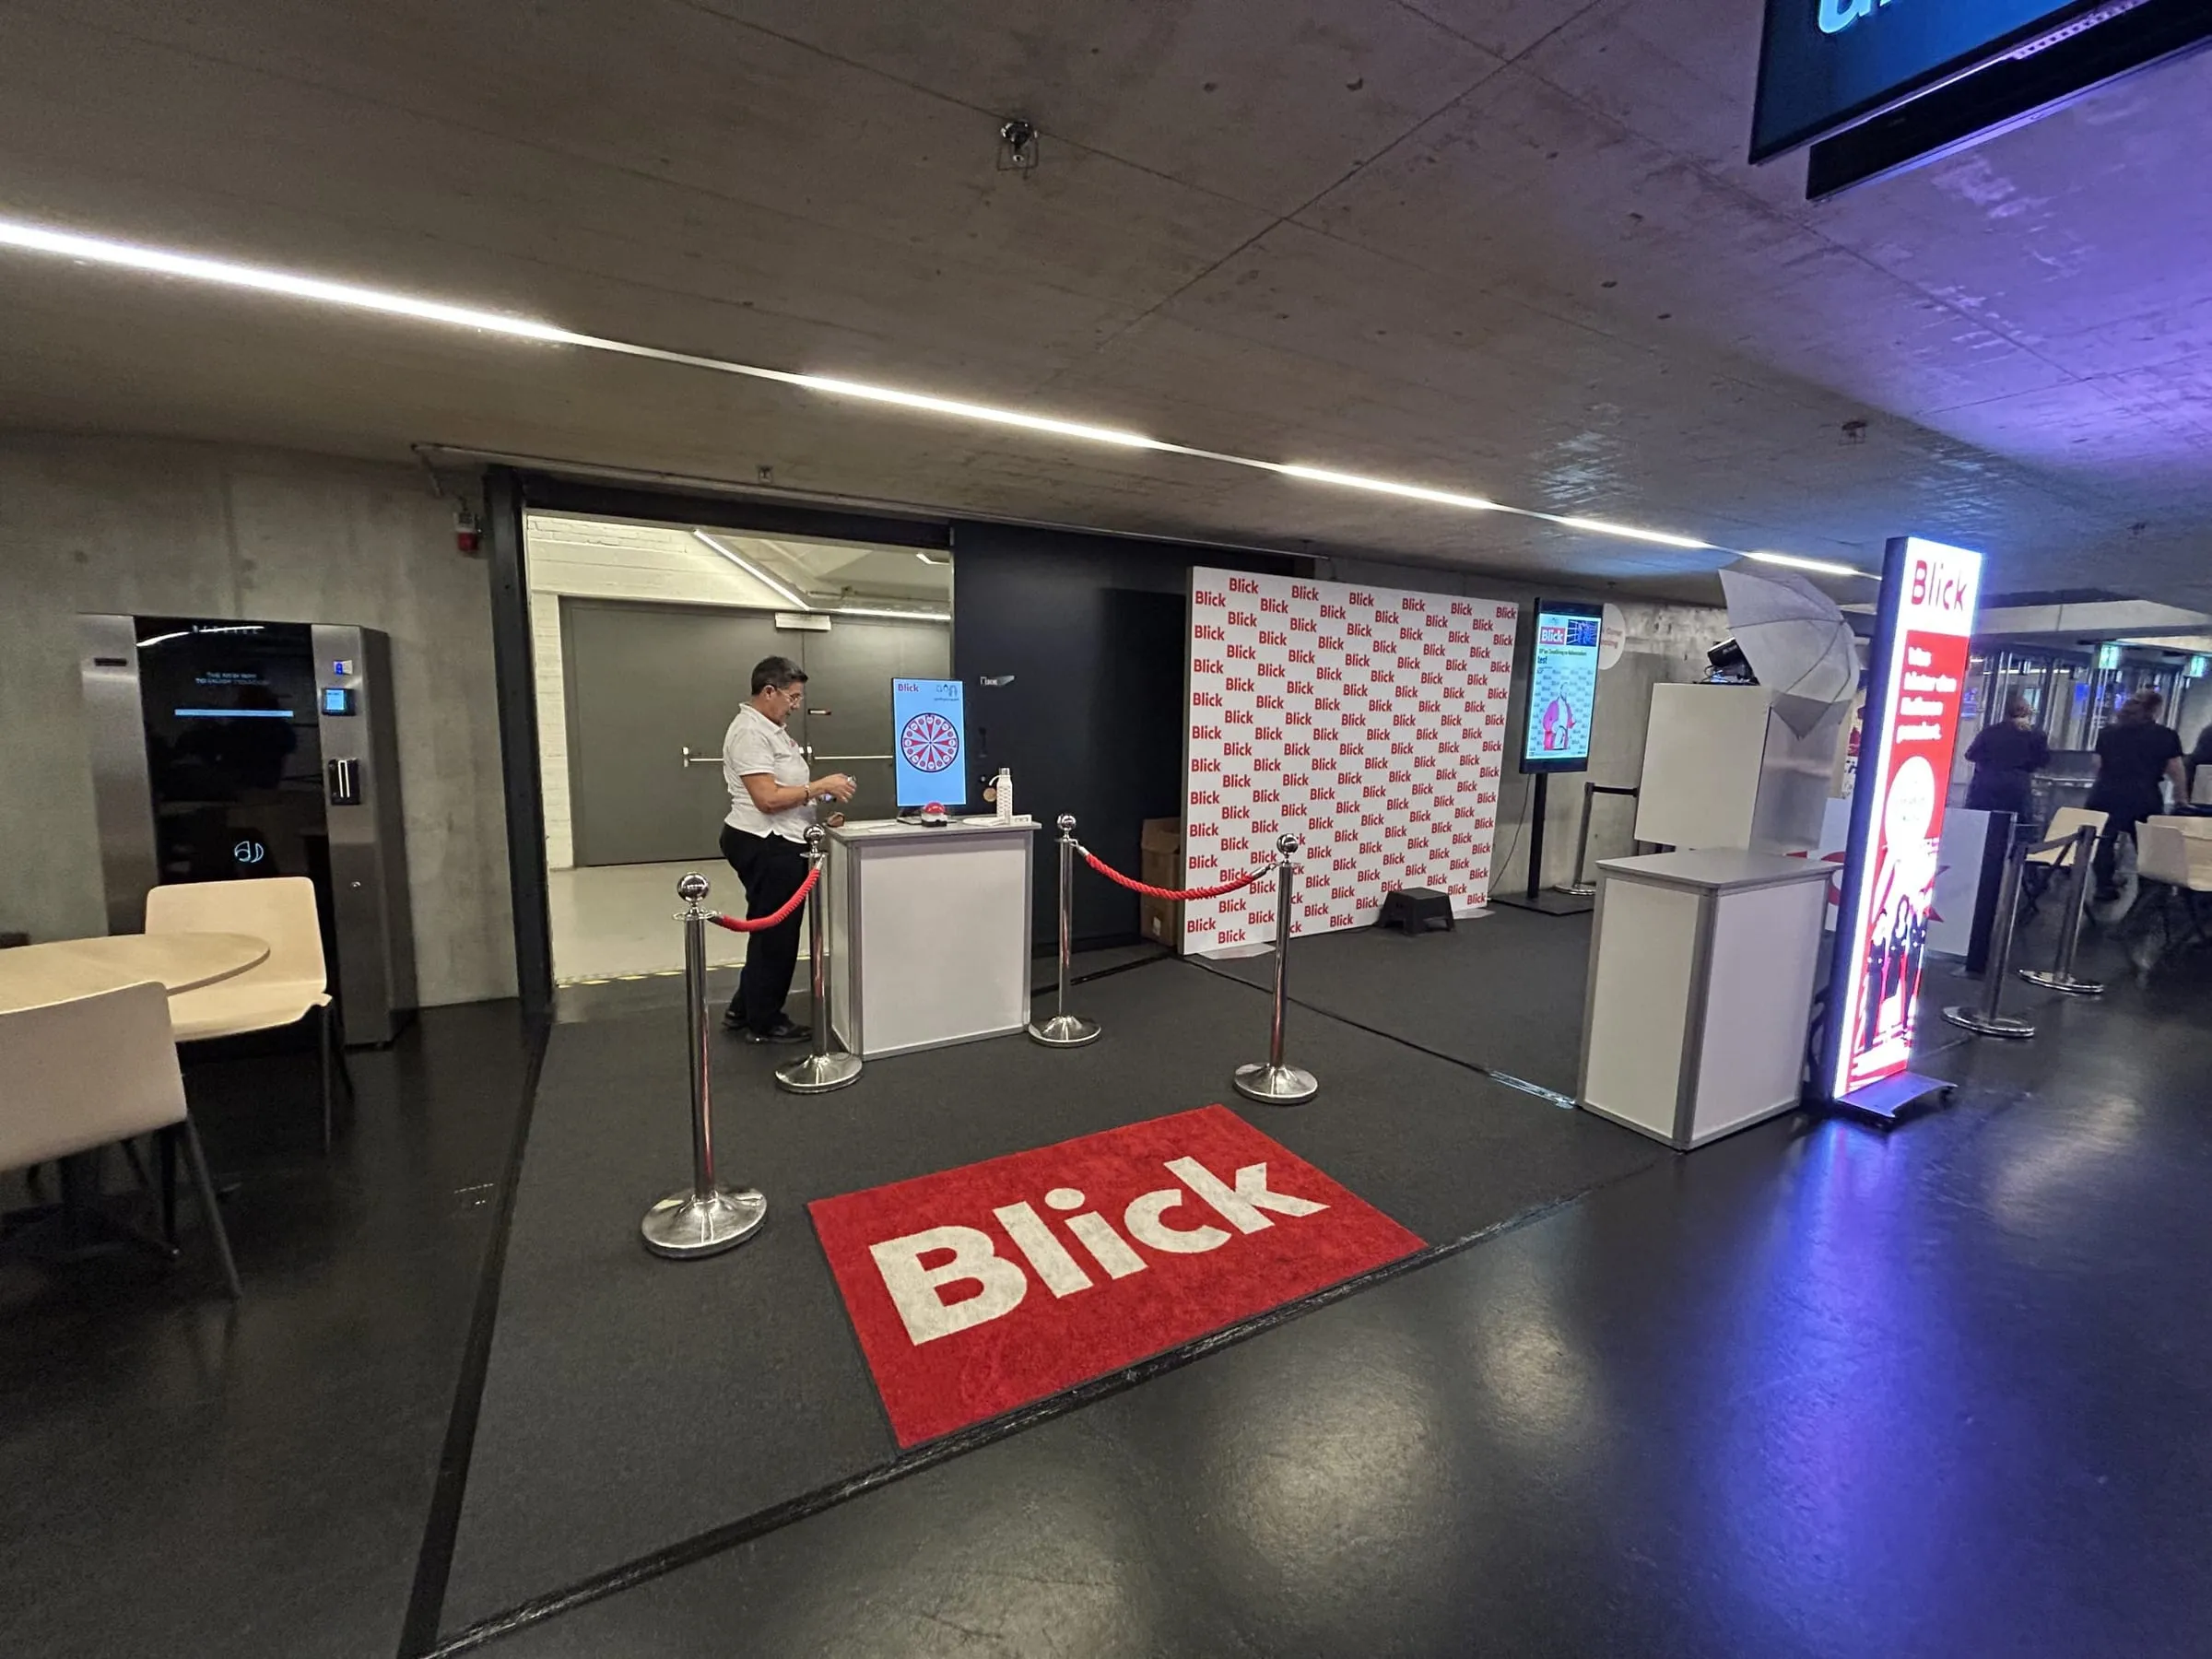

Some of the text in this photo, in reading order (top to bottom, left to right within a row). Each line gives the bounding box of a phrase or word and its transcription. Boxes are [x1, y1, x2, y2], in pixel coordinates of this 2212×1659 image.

[1230, 577, 1259, 594] Blick
[1911, 559, 1967, 612] Blick
[1195, 591, 1226, 607] Blick
[1292, 585, 1319, 601] Blick
[1349, 592, 1374, 606] Blick
[1261, 597, 1288, 614] Blick
[1402, 597, 1426, 612] Blick
[1451, 603, 1473, 616] Blick
[1320, 605, 1346, 619] Blick
[1375, 610, 1399, 625] Blick
[1496, 606, 1516, 618] Blick
[1228, 611, 1257, 627] Blick
[1290, 618, 1317, 632] Blick
[1426, 615, 1448, 628] Blick
[1473, 618, 1493, 631] Blick
[1194, 625, 1224, 641] Blick
[1347, 623, 1371, 637] Blick
[1400, 627, 1423, 641] Blick
[1448, 630, 1470, 643] Blick
[1542, 629, 1564, 642] Blick
[1259, 630, 1287, 646] Blick
[1318, 636, 1344, 650] Blick
[1493, 634, 1512, 646] Blick
[1227, 644, 1256, 660] Blick
[1373, 640, 1397, 653] Blick
[1423, 643, 1445, 656] Blick
[1469, 646, 1490, 658] Blick
[1288, 649, 1315, 664] Blick
[1346, 653, 1370, 667] Blick
[1397, 656, 1420, 669] Blick
[1194, 658, 1224, 674] Blick
[1257, 664, 1285, 677] Blick
[1445, 658, 1467, 671] Blick
[1490, 661, 1511, 674] Blick
[1316, 667, 1342, 680] Blick
[1371, 670, 1394, 683] Blick
[1420, 672, 1442, 685] Blick
[1467, 674, 1488, 686] Blick
[898, 683, 919, 692] Blick
[1226, 677, 1254, 692] Blick
[1287, 680, 1314, 695] Blick
[1343, 684, 1368, 697] Blick
[1395, 686, 1418, 698] Blick
[1443, 687, 1465, 699] Blick
[1488, 688, 1508, 700] Blick
[1194, 692, 1222, 707] Blick
[1256, 695, 1284, 709] Blick
[1314, 697, 1340, 711] Blick
[1369, 699, 1392, 712] Blick
[1418, 700, 1441, 712] Blick
[1465, 700, 1486, 712] Blick
[1225, 710, 1253, 724] Blick
[1285, 712, 1312, 725] Blick
[1342, 713, 1366, 726] Blick
[1394, 714, 1416, 726] Blick
[1441, 714, 1462, 726] Blick
[1485, 714, 1504, 725] Blick
[1193, 724, 1222, 739] Blick
[1255, 726, 1283, 740] Blick
[1313, 727, 1338, 741] Blick
[1367, 728, 1390, 741] Blick
[1416, 728, 1438, 740] Blick
[1462, 728, 1482, 739] Blick
[1224, 742, 1252, 756] Blick
[1284, 743, 1311, 756] Blick
[1339, 743, 1364, 756] Blick
[1391, 742, 1414, 755] Blick
[1438, 741, 1460, 754] Blick
[1482, 740, 1501, 752] Blick
[1192, 758, 1220, 772] Blick
[1253, 758, 1281, 771] Blick
[1312, 758, 1336, 771] Blick
[1365, 758, 1388, 769] Blick
[1414, 756, 1436, 768] Blick
[1460, 754, 1480, 766] Blick
[1338, 772, 1362, 784] Blick
[1389, 771, 1411, 782] Blick
[1436, 769, 1457, 781] Blick
[1479, 767, 1499, 778] Blick
[1223, 774, 1251, 788] Blick
[1283, 773, 1309, 786] Blick
[1310, 787, 1335, 800] Blick
[1362, 785, 1386, 798] Blick
[1412, 783, 1433, 795] Blick
[1457, 781, 1477, 793] Blick
[1191, 791, 1220, 805] Blick
[1253, 789, 1279, 803] Blick
[1434, 795, 1454, 807] Blick
[1477, 792, 1496, 804] Blick
[1281, 804, 1307, 817] Blick
[1336, 801, 1360, 814] Blick
[1387, 798, 1409, 811] Blick
[1222, 806, 1250, 819] Blick
[1409, 810, 1430, 822] Blick
[1454, 806, 1475, 818] Blick
[1252, 819, 1278, 833] Blick
[1309, 817, 1334, 830] Blick
[1360, 813, 1384, 826] Blick
[1475, 818, 1493, 830] Blick
[1190, 822, 1218, 837] Blick
[1384, 826, 1407, 839] Blick
[1431, 821, 1453, 833] Blick
[1335, 830, 1359, 842] Blick
[1453, 832, 1472, 844] Blick
[1220, 837, 1249, 851] Blick
[1359, 841, 1382, 854] Blick
[1407, 837, 1429, 850] Blick
[1472, 842, 1490, 855] Blick
[1250, 850, 1277, 865] Blick
[1307, 846, 1332, 859] Blick
[1382, 853, 1405, 865] Blick
[1429, 848, 1450, 860] Blick
[1189, 854, 1218, 869] Blick
[1333, 858, 1357, 871] Blick
[1450, 857, 1469, 870] Blick
[1358, 869, 1381, 882] Blick
[1406, 865, 1427, 877] Blick
[1469, 868, 1488, 880] Blick
[1306, 874, 1330, 888] Blick
[1381, 879, 1403, 893] Blick
[1427, 874, 1447, 886] Blick
[1249, 880, 1276, 895] Blick
[1331, 887, 1355, 900] Blick
[1447, 884, 1467, 896] Blick
[1218, 898, 1246, 913] Blick
[1356, 897, 1379, 910] Blick
[1467, 893, 1486, 905] Blick
[1304, 903, 1329, 917] Blick
[1248, 910, 1275, 924] Blick
[1330, 914, 1354, 927] Blick
[1187, 917, 1217, 933] Blick
[1218, 929, 1246, 944] Blick
[869, 1156, 1329, 1345] Blick
